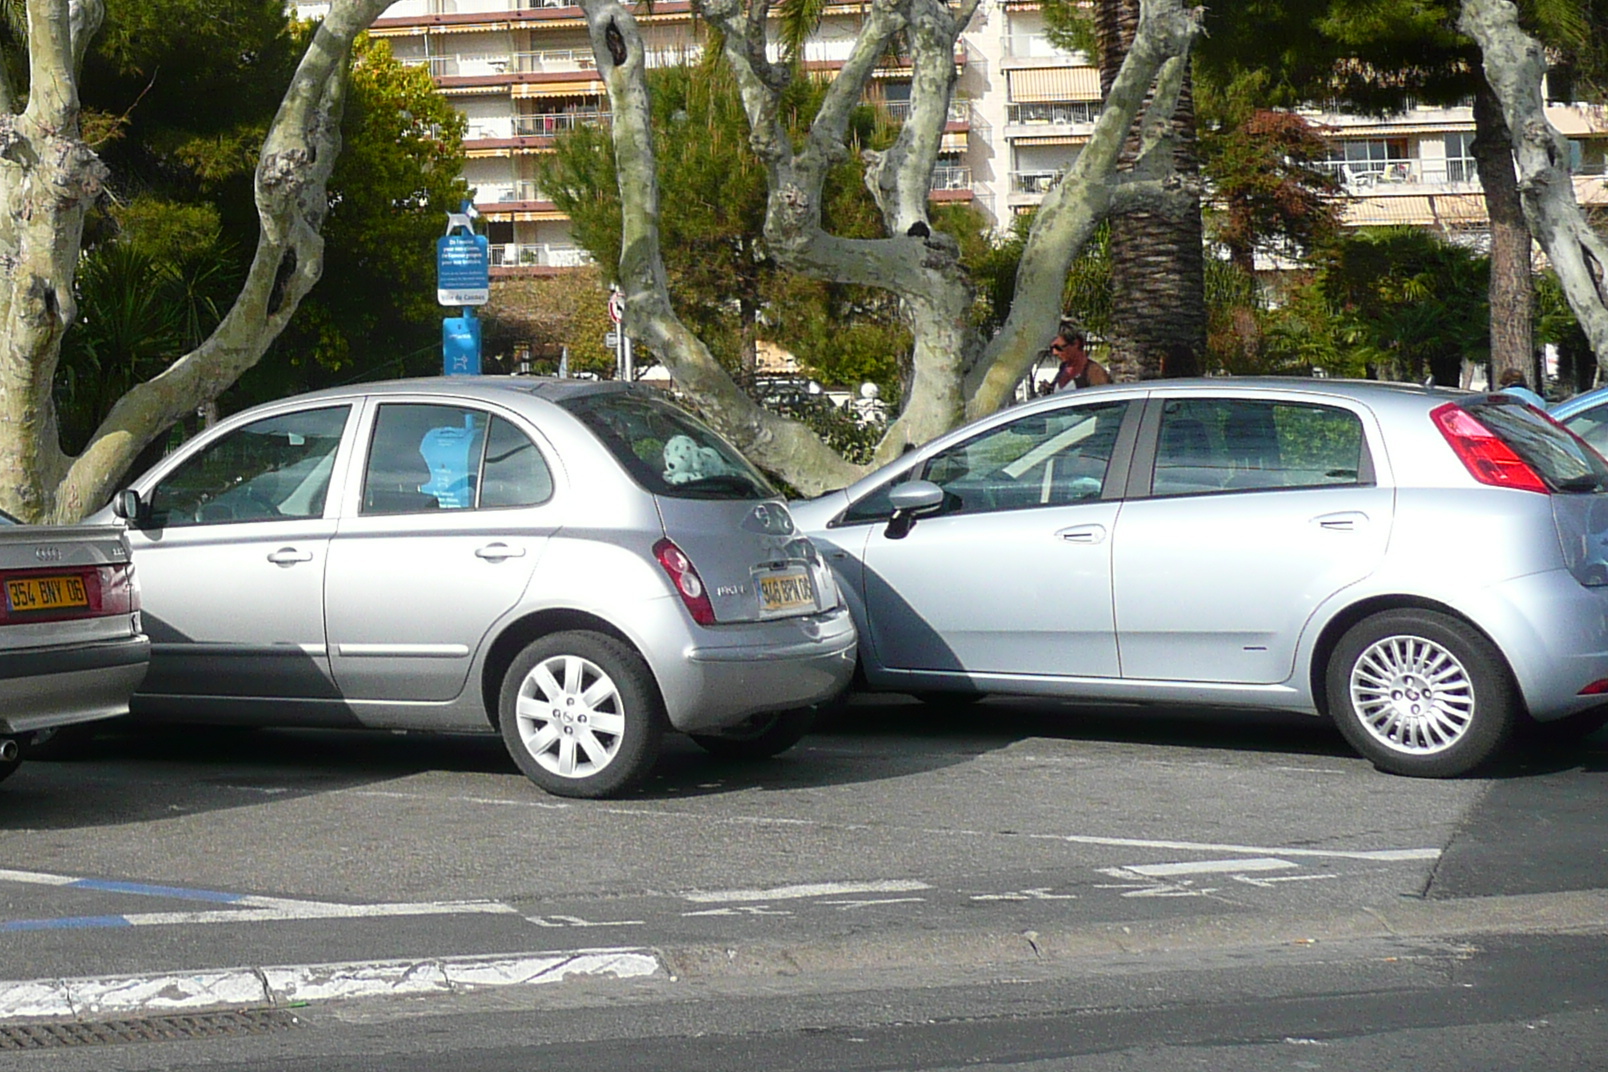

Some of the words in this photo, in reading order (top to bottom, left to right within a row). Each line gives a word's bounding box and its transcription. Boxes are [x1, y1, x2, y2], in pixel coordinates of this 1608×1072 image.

[10, 582, 36, 607] 354
[38, 580, 63, 604] BNY
[66, 579, 84, 601] 06
[762, 580, 781, 604] 946
[781, 578, 801, 601] BPN
